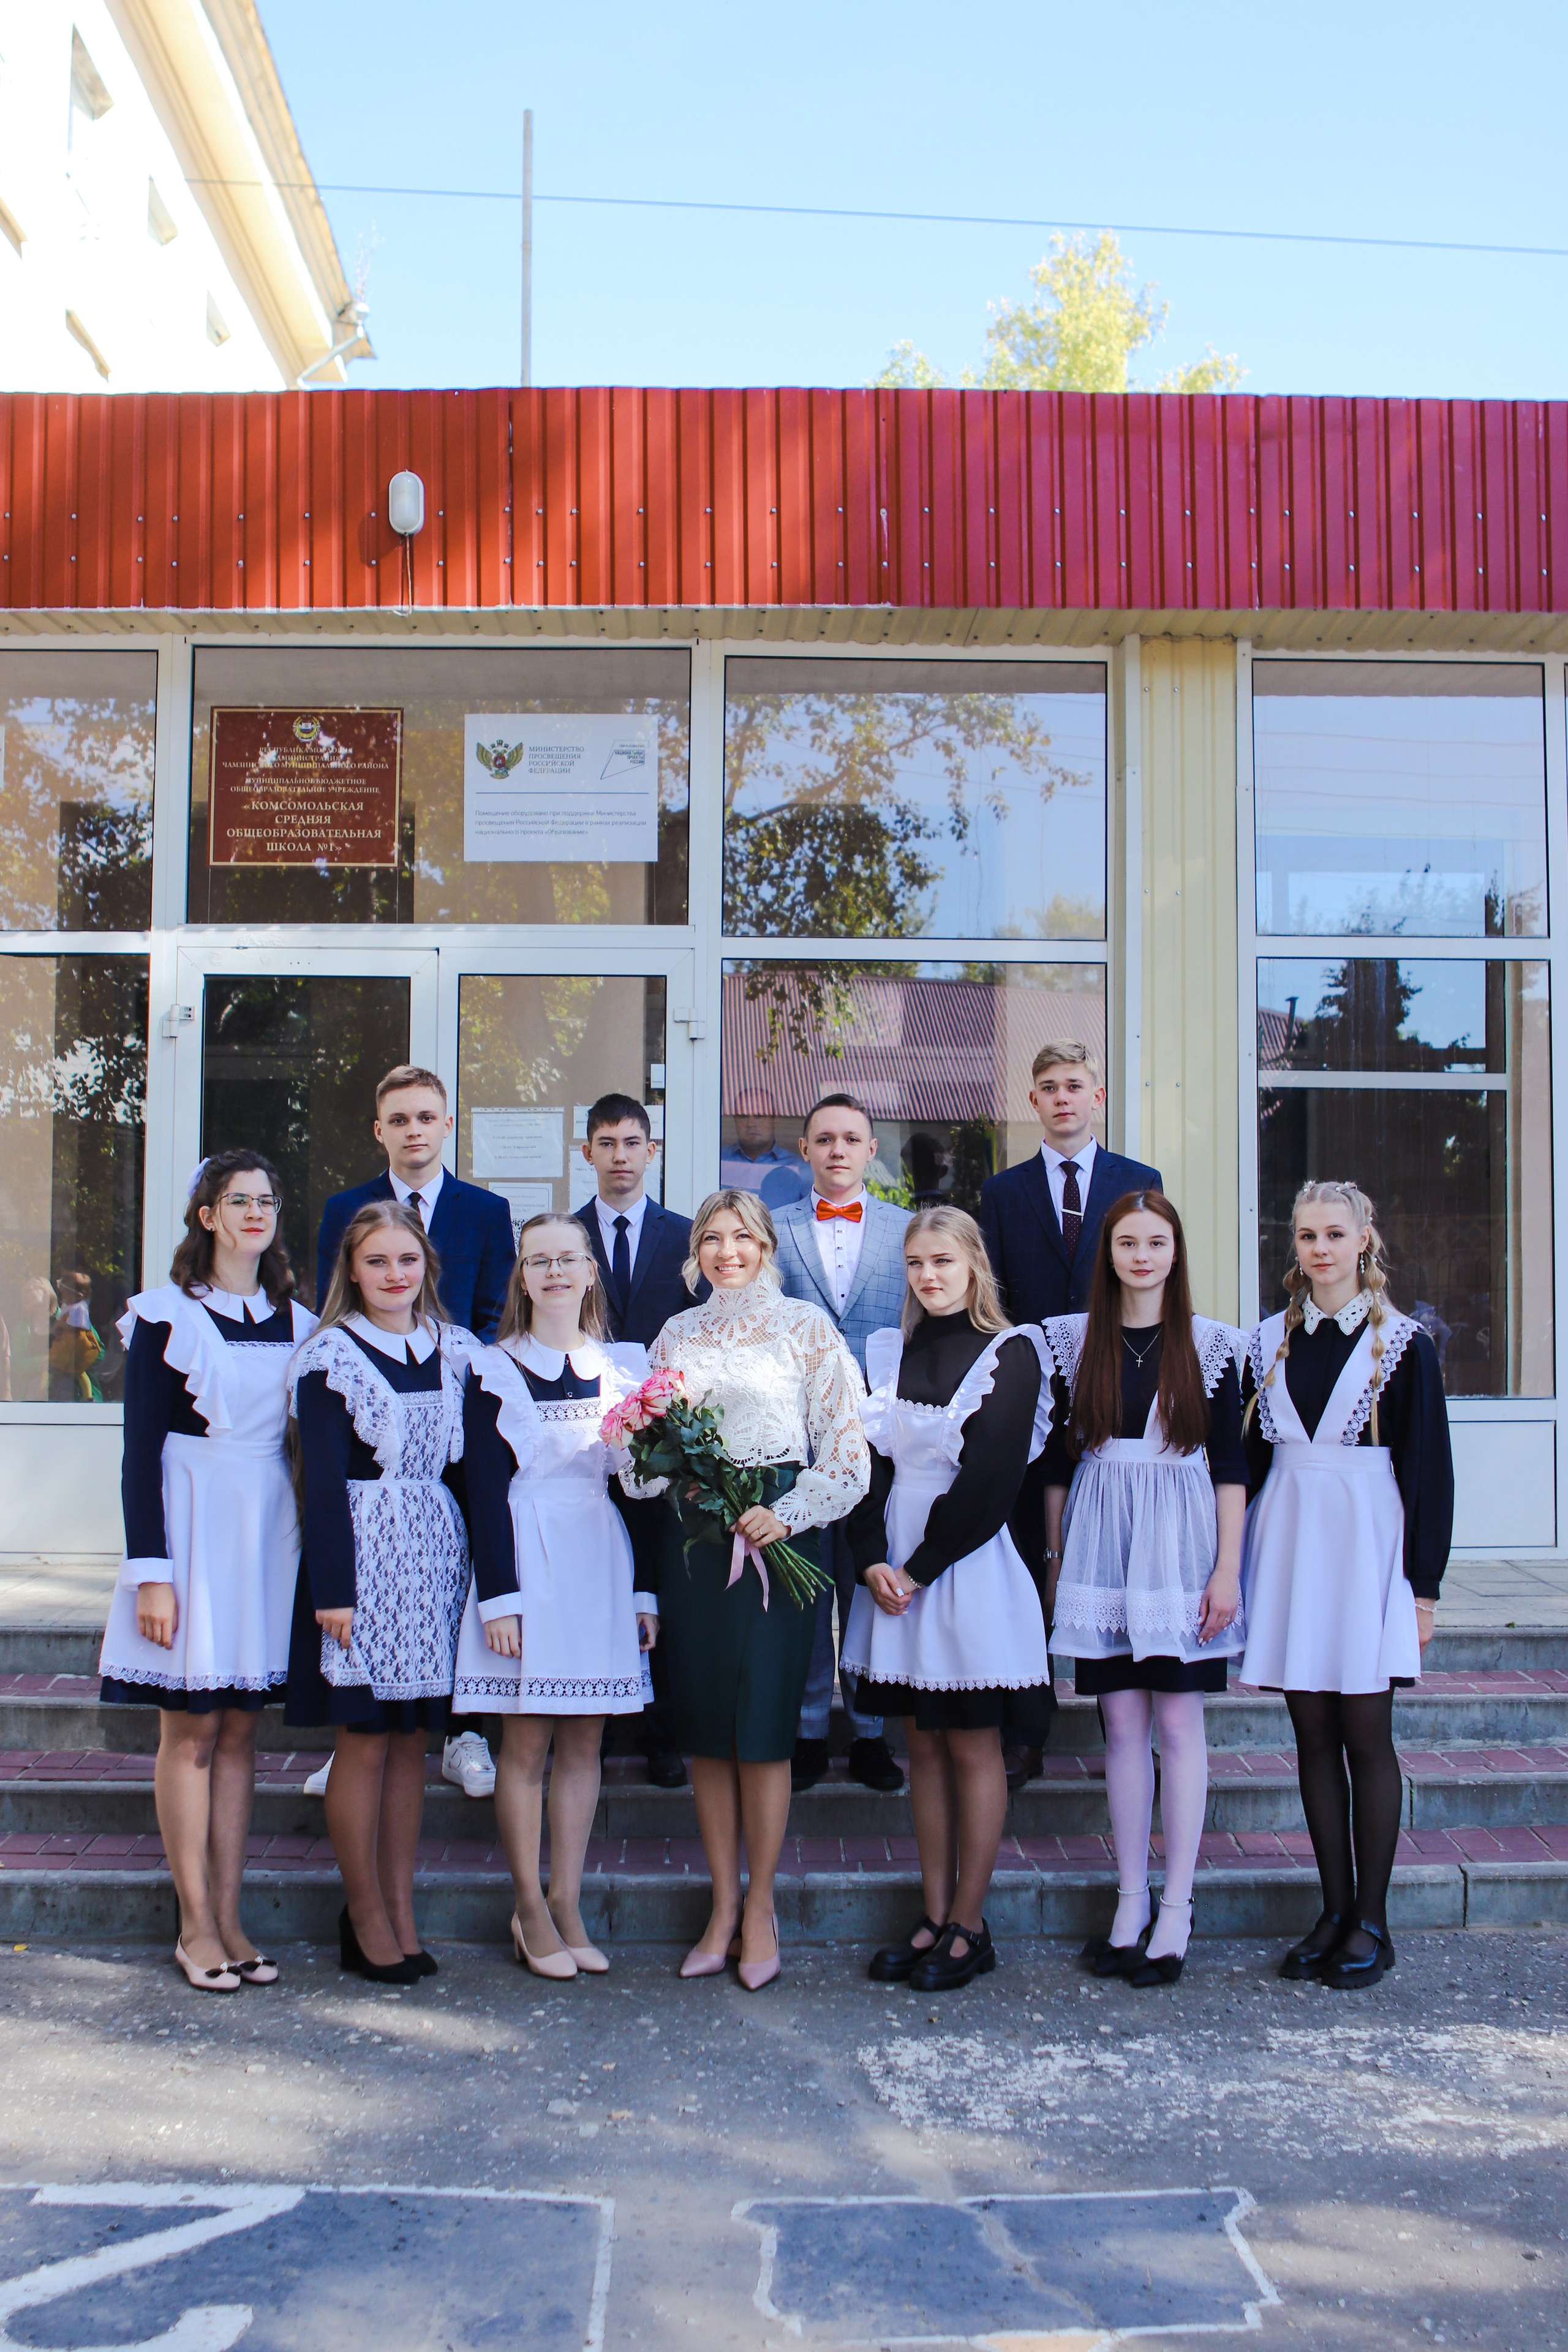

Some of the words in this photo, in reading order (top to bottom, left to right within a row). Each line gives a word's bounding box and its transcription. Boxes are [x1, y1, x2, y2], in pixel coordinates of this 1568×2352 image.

[243, 801, 364, 810] «КОМСОМОЛЬСКАЯ
[275, 815, 331, 826] СРЕДНЯЯ
[227, 828, 382, 839] ОБЩЕОБРАЗОВАТЕЛЬНАЯ
[266, 842, 312, 851] ШКОЛА
